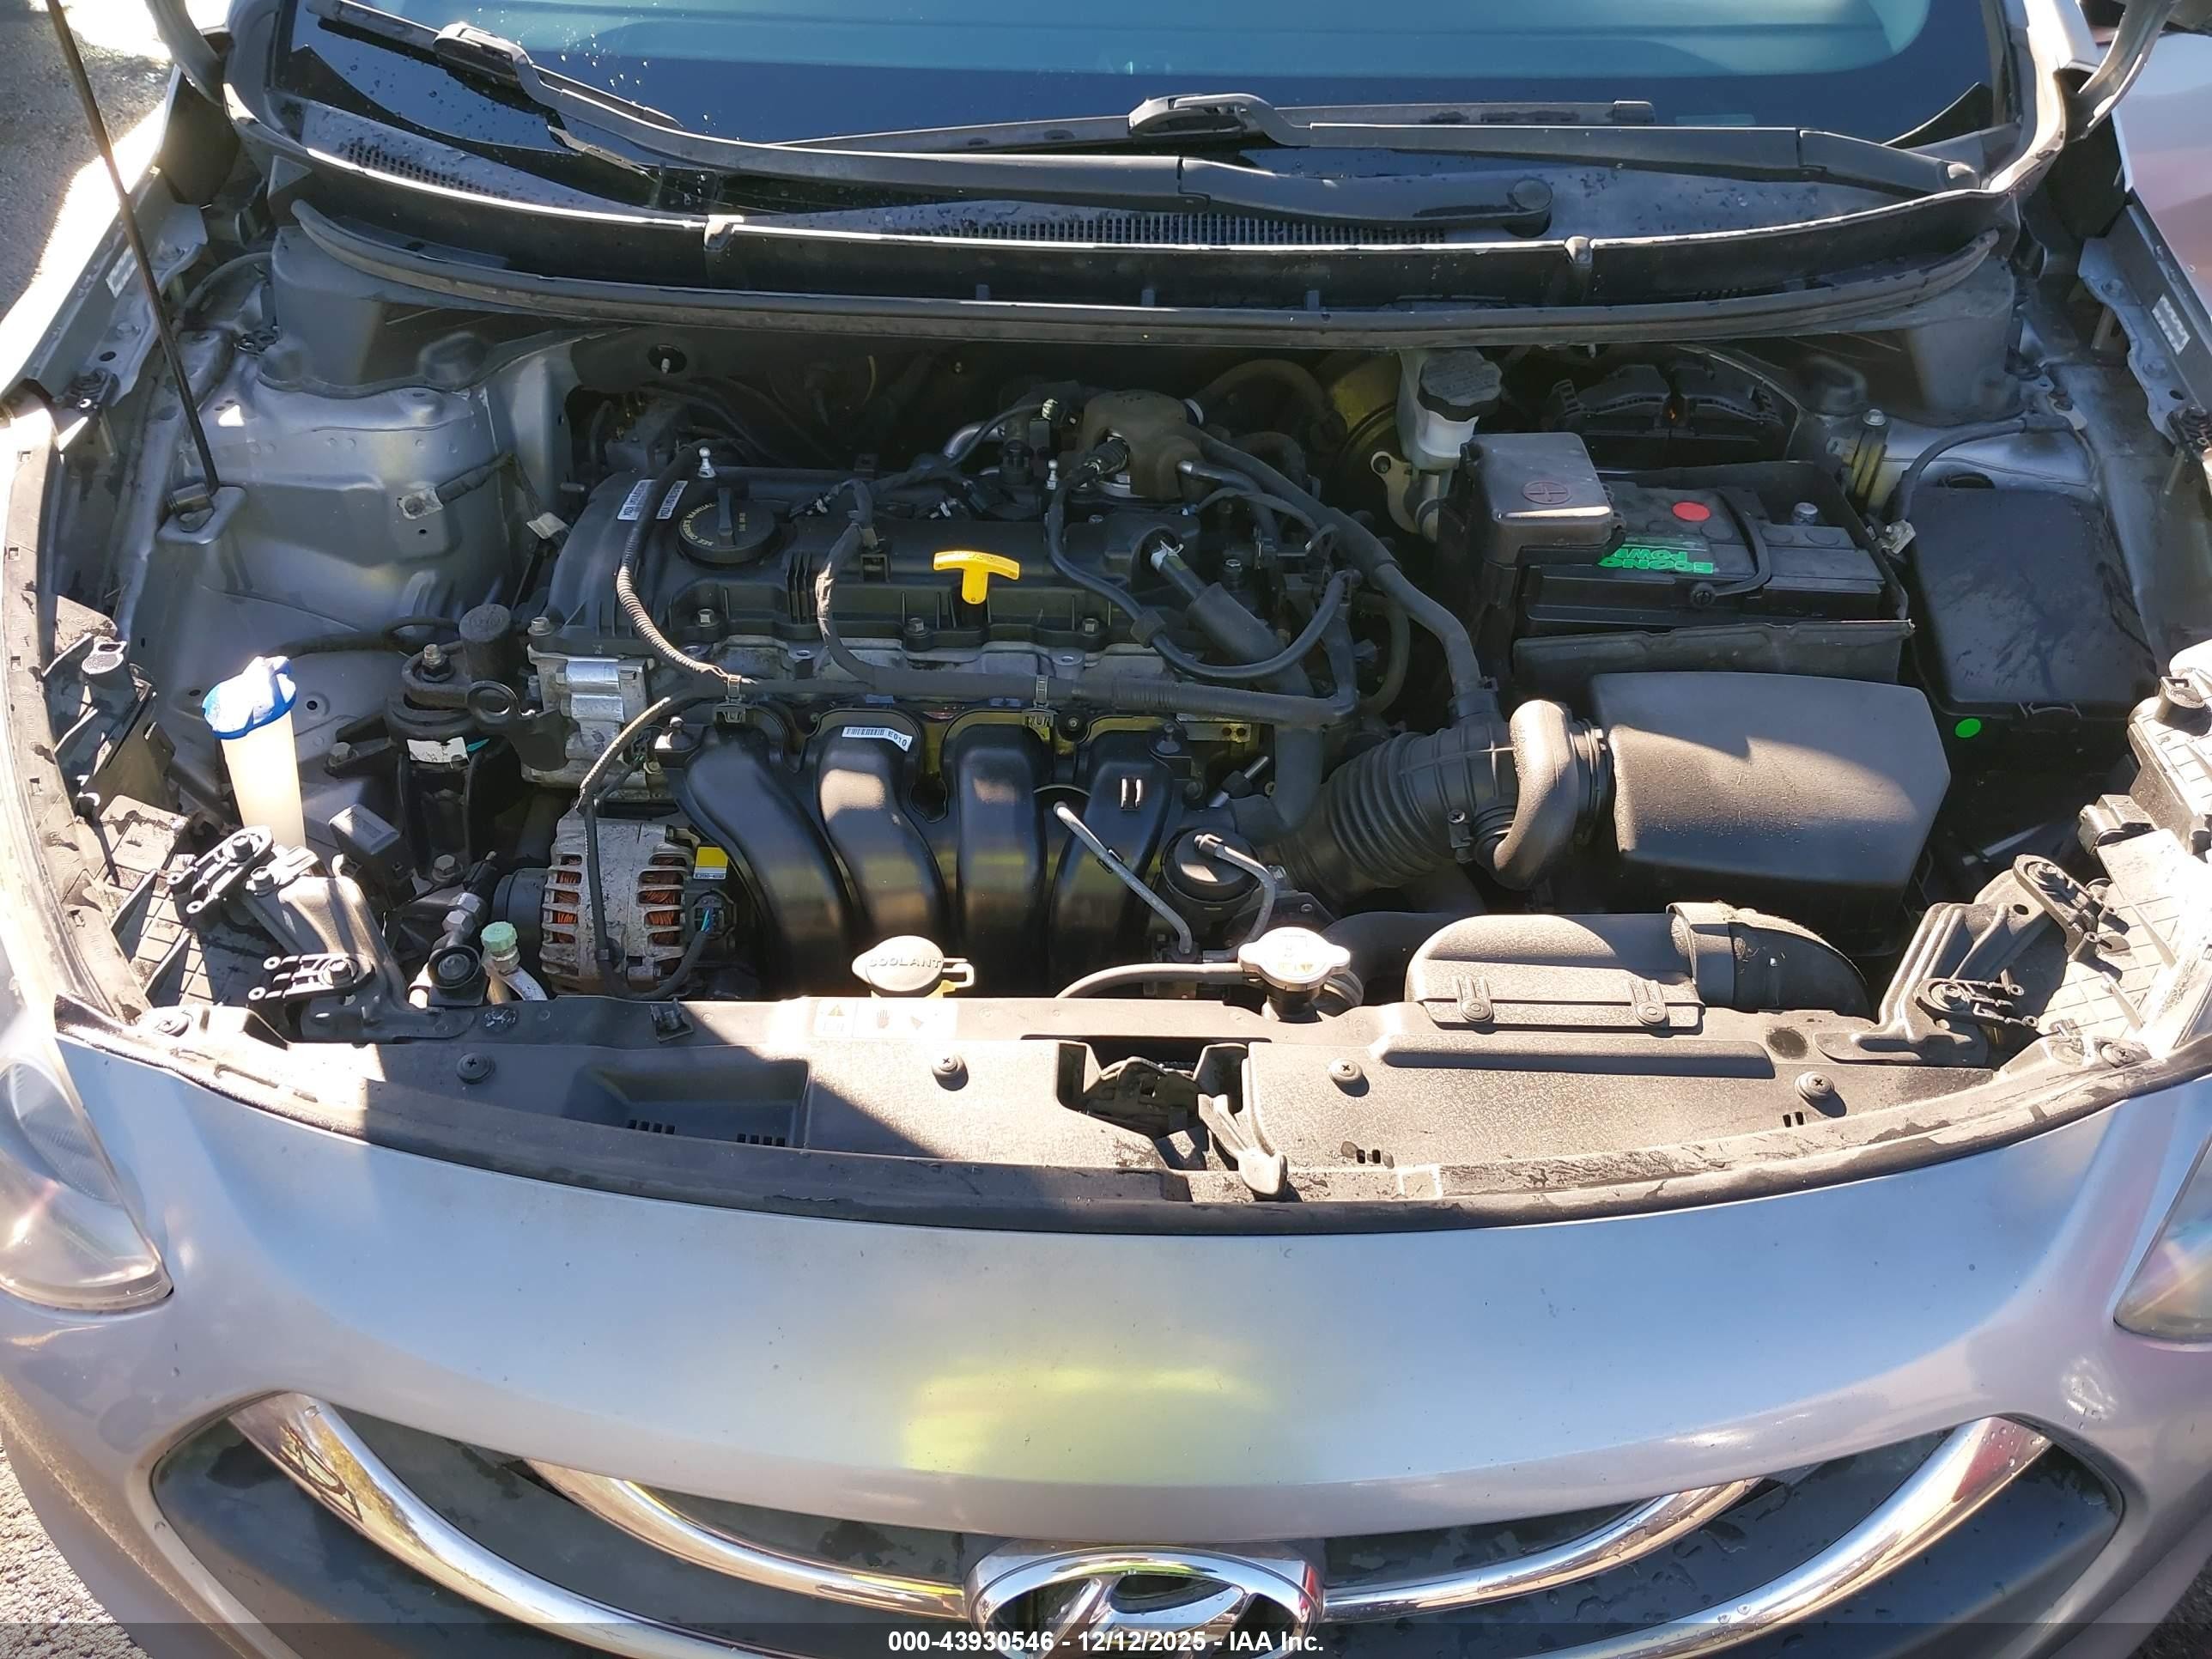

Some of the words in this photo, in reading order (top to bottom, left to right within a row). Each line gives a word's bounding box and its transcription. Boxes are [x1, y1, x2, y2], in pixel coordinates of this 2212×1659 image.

[696, 538, 714, 547] SEE
[1598, 556, 1713, 574] ECONO
[887, 731, 908, 747] E010
[868, 955, 942, 969] COOLANT
